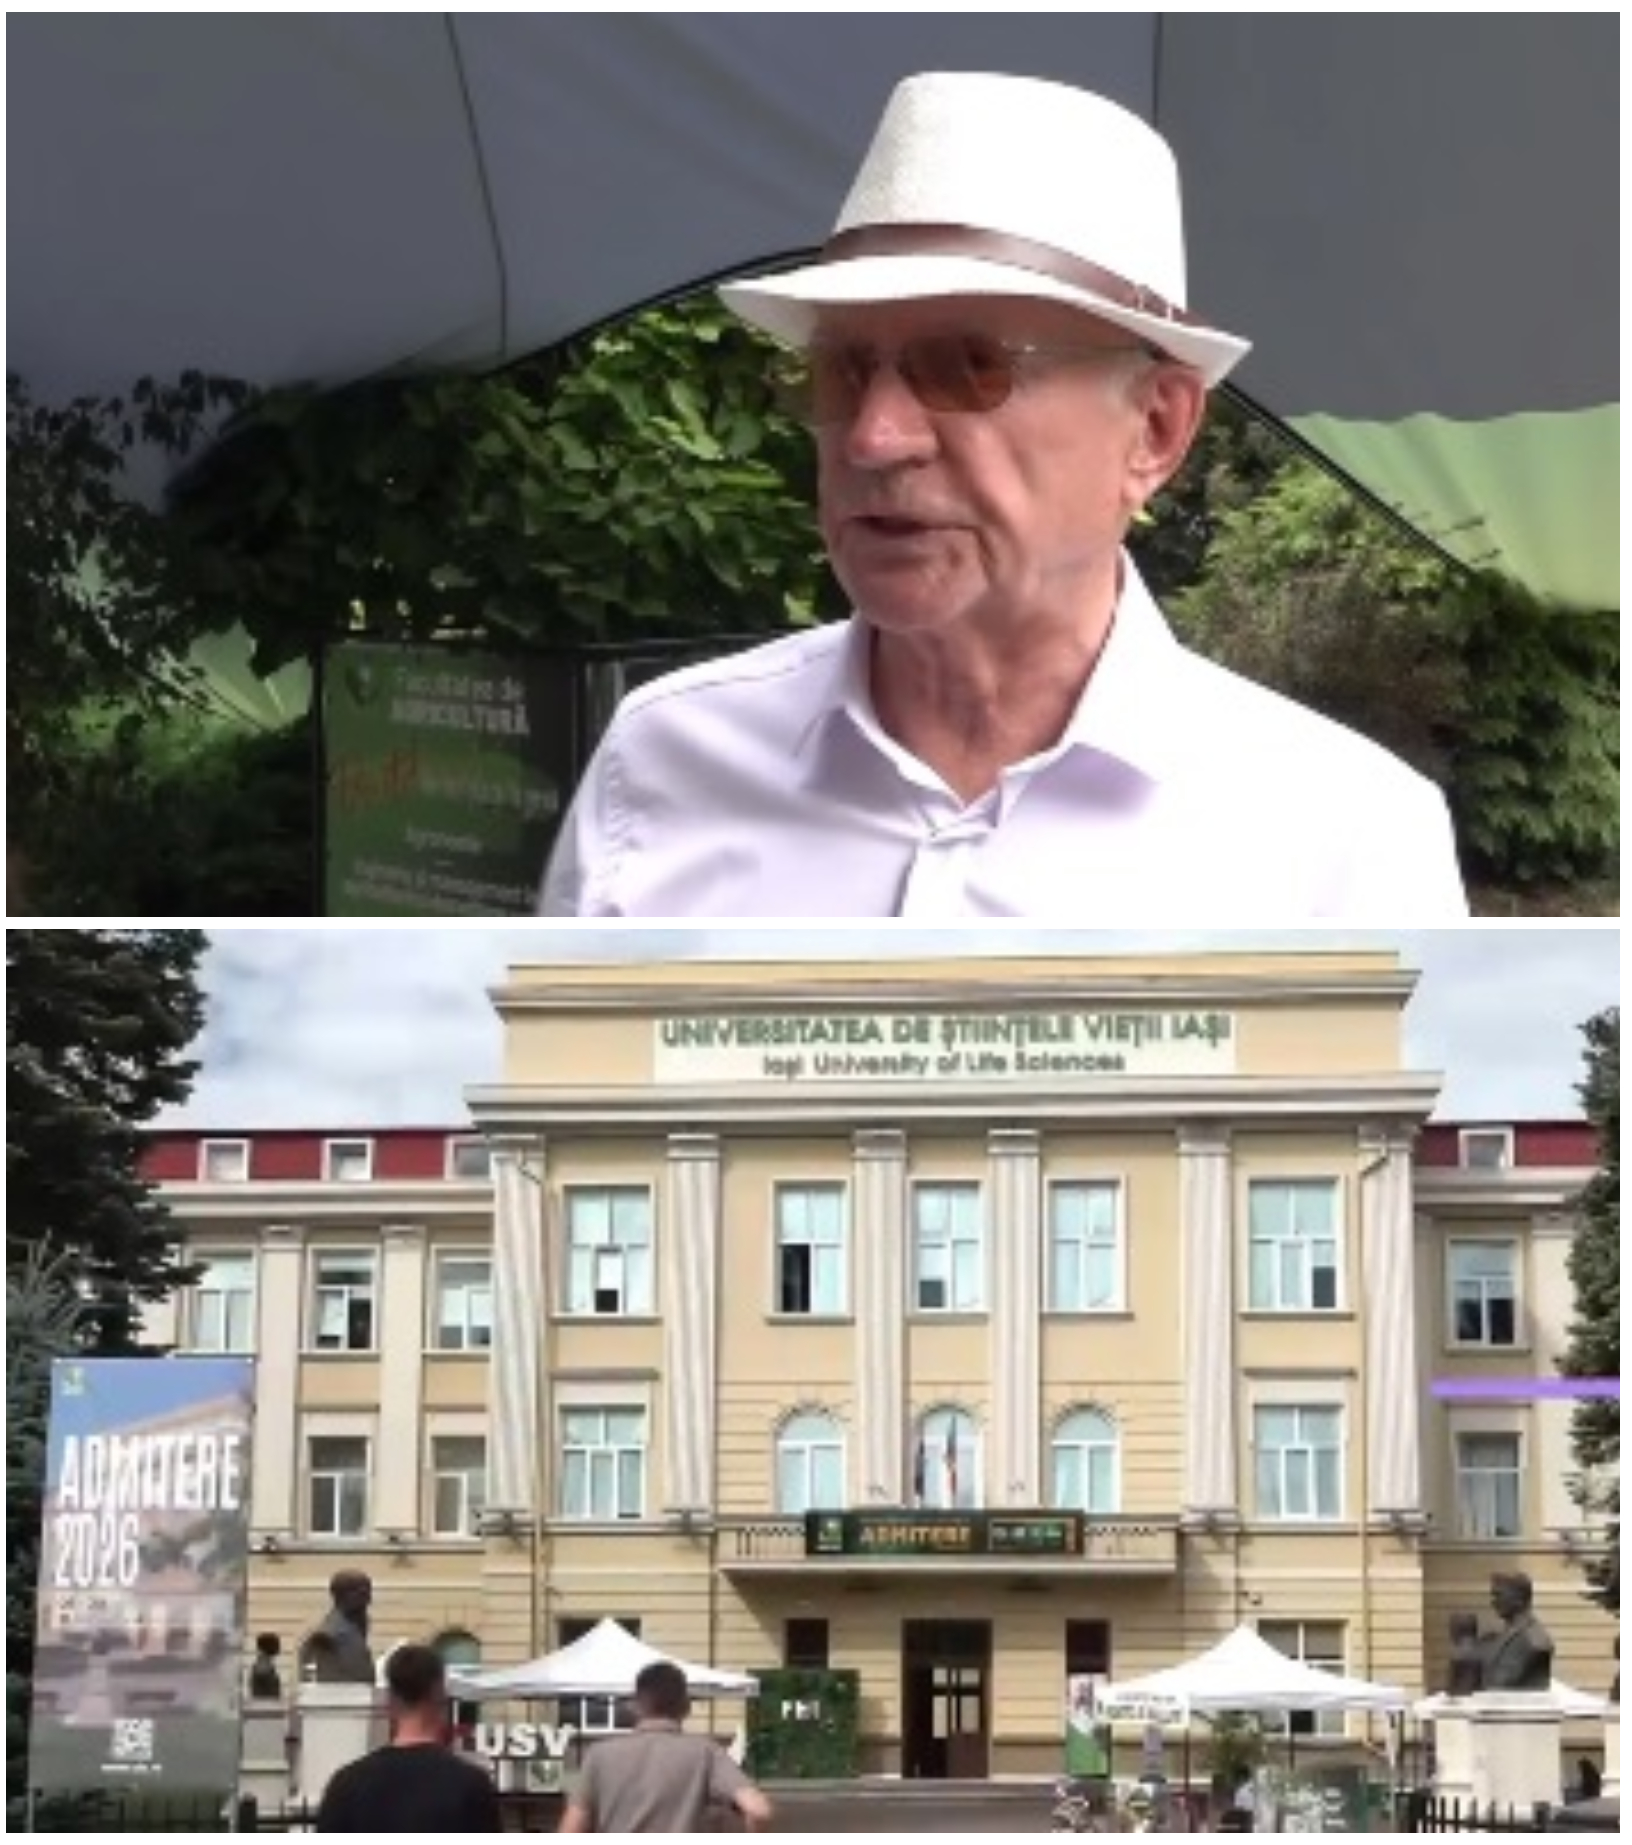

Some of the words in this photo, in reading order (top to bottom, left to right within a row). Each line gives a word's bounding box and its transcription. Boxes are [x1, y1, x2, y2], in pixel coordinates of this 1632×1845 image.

[663, 1016, 884, 1046] UNIVERSITATEA
[892, 1017, 931, 1043] DE
[814, 1052, 929, 1077] University
[936, 1051, 960, 1073] of
[966, 1051, 1008, 1073] Life
[1014, 1052, 1126, 1073] Sciences
[55, 1434, 241, 1511] ADMITERE
[54, 1513, 141, 1588] 2026
[475, 1722, 574, 1757] USV
